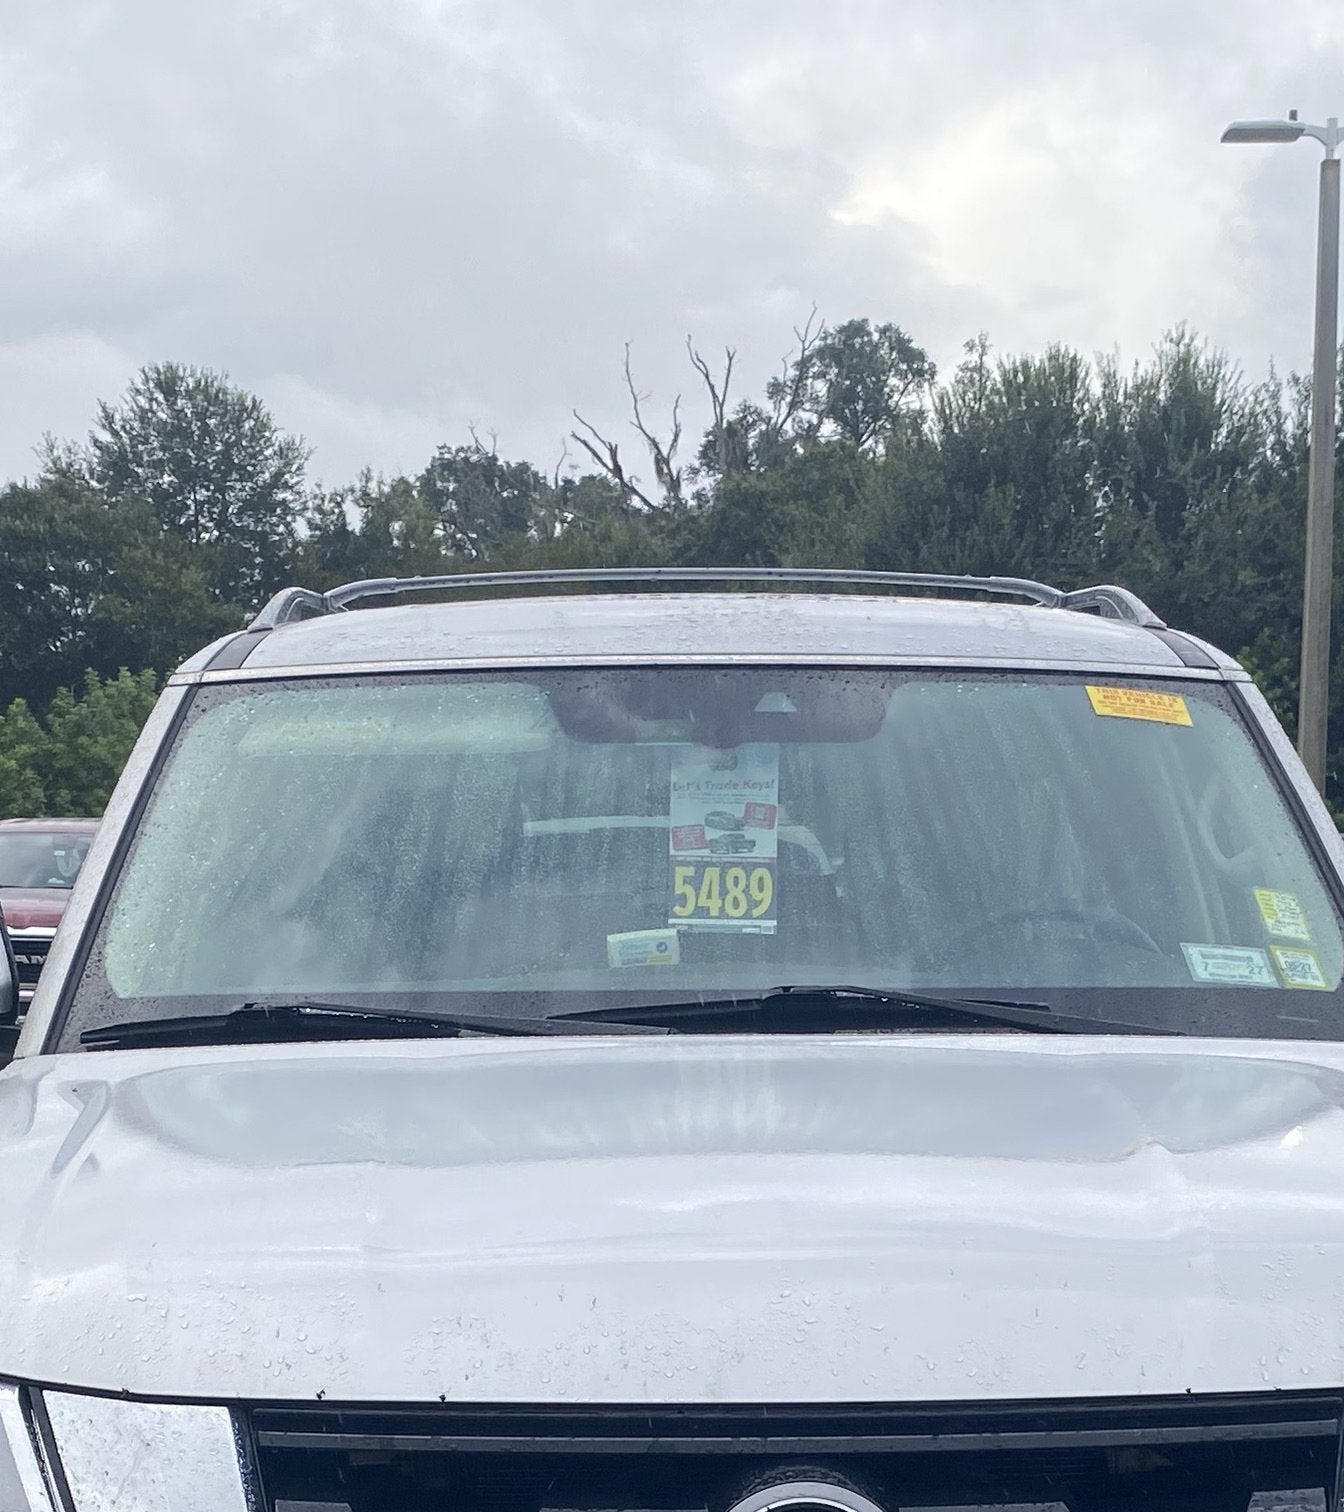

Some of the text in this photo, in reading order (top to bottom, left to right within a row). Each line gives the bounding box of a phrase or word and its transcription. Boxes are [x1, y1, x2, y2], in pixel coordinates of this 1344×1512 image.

[705, 780, 739, 790] Trade
[743, 779, 775, 791] Keys!
[672, 865, 773, 918] 5489
